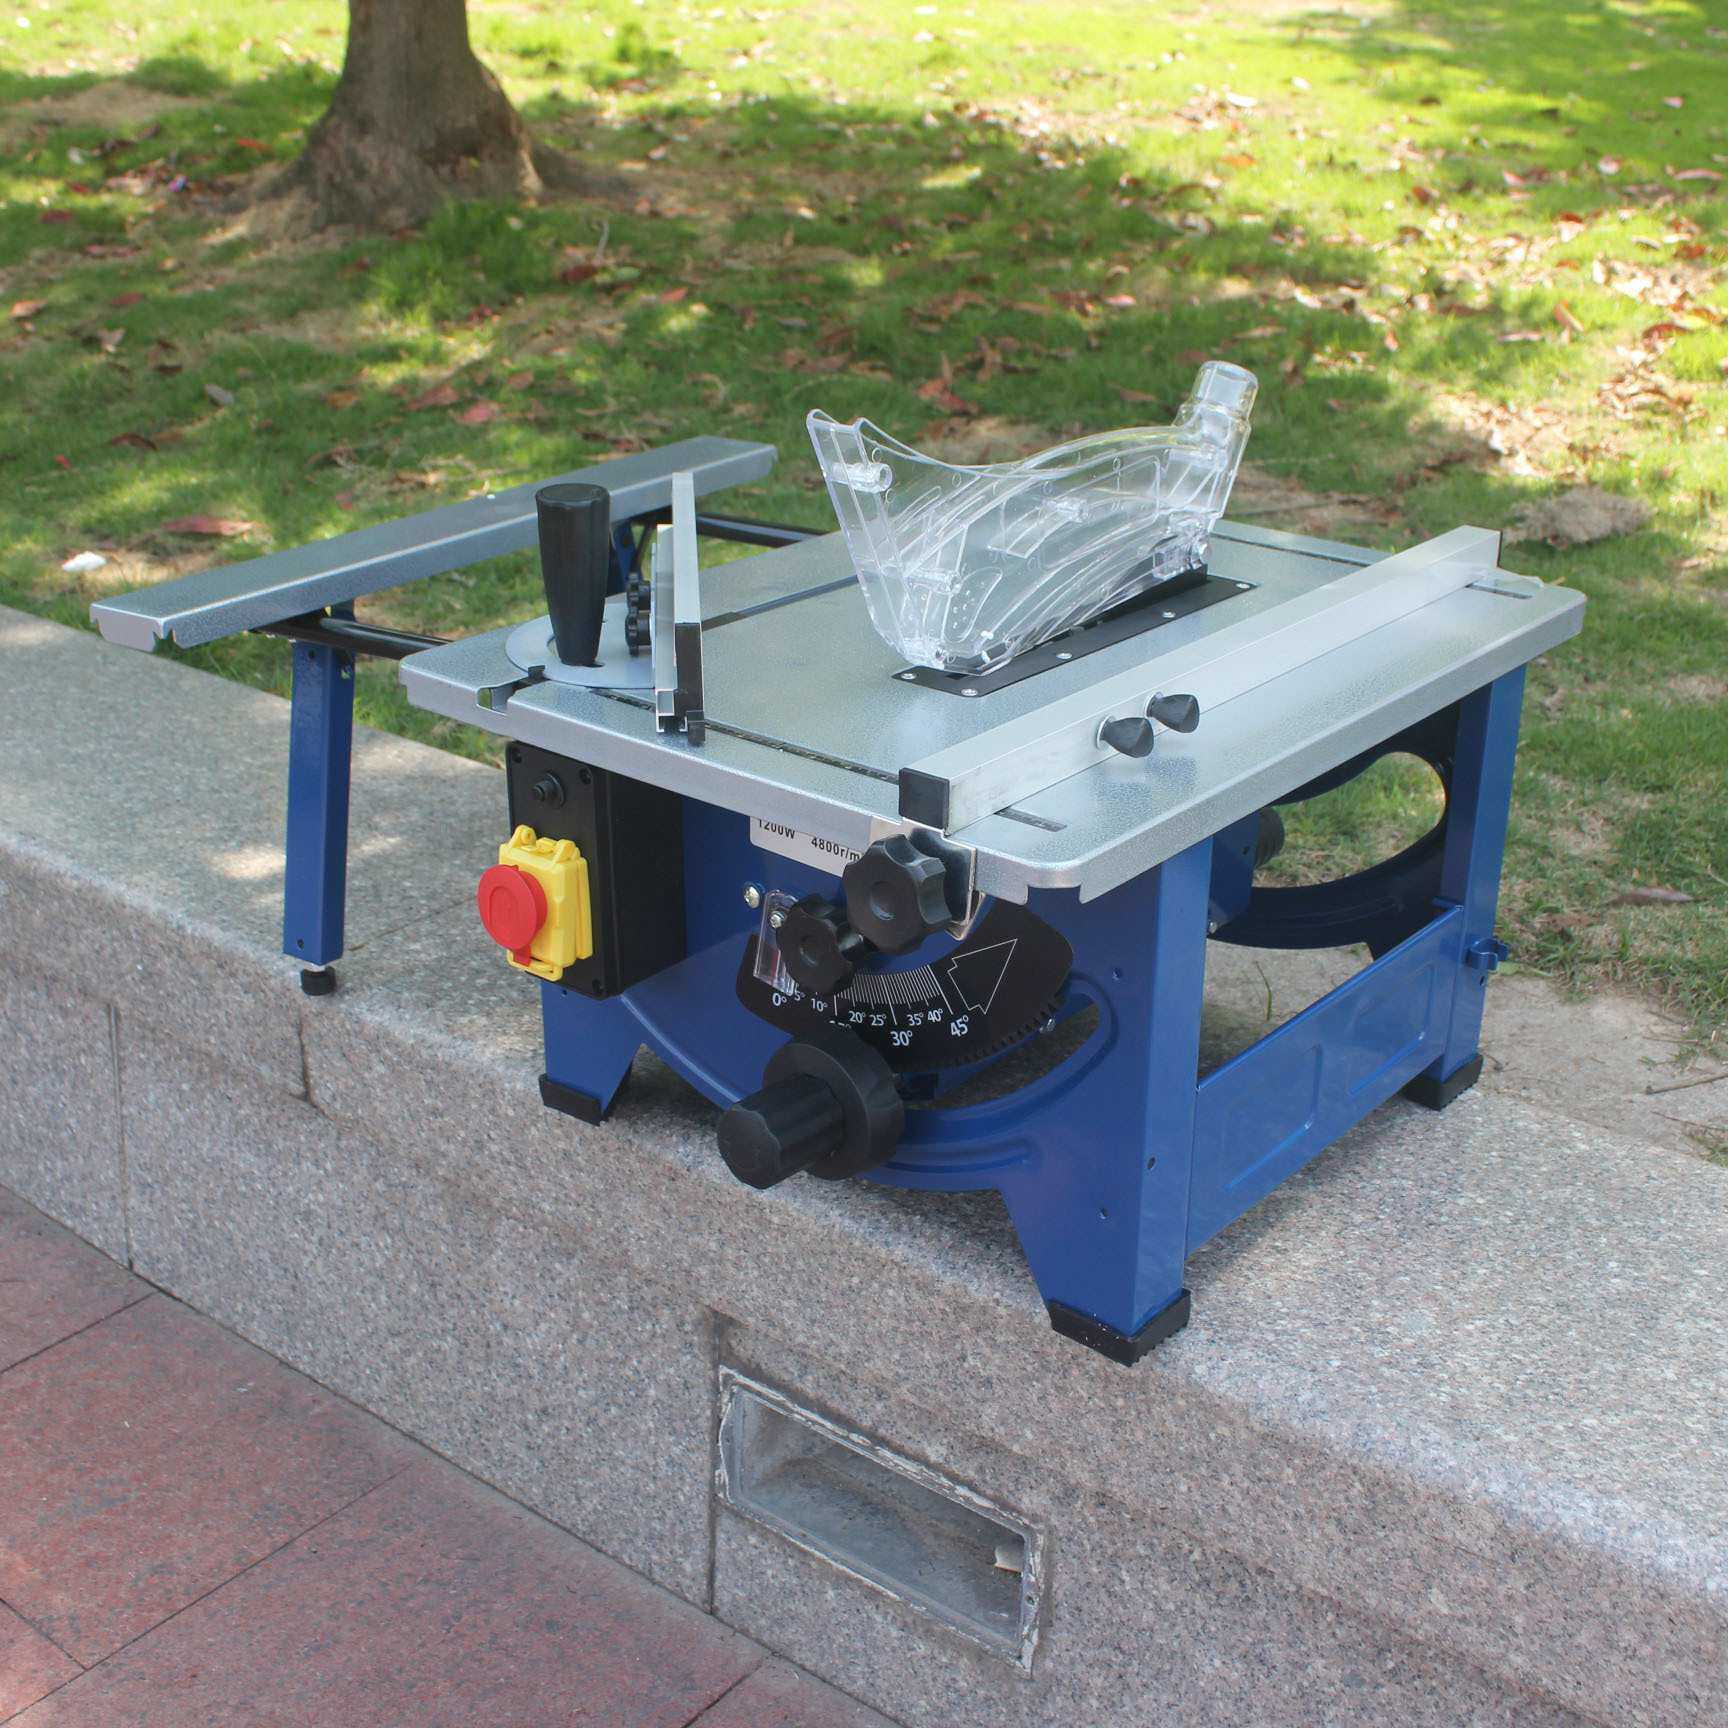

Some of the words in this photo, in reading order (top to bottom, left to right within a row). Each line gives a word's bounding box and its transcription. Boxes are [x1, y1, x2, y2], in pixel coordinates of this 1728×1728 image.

[759, 819, 795, 840] 1200W
[811, 998, 828, 1012] 10°
[848, 1010, 866, 1023] 20°
[869, 1013, 887, 1026] 25°
[890, 1030, 913, 1046] 30°
[906, 1012, 924, 1026] 35°
[927, 1008, 943, 1023] 40°
[950, 1014, 969, 1037] 45°
